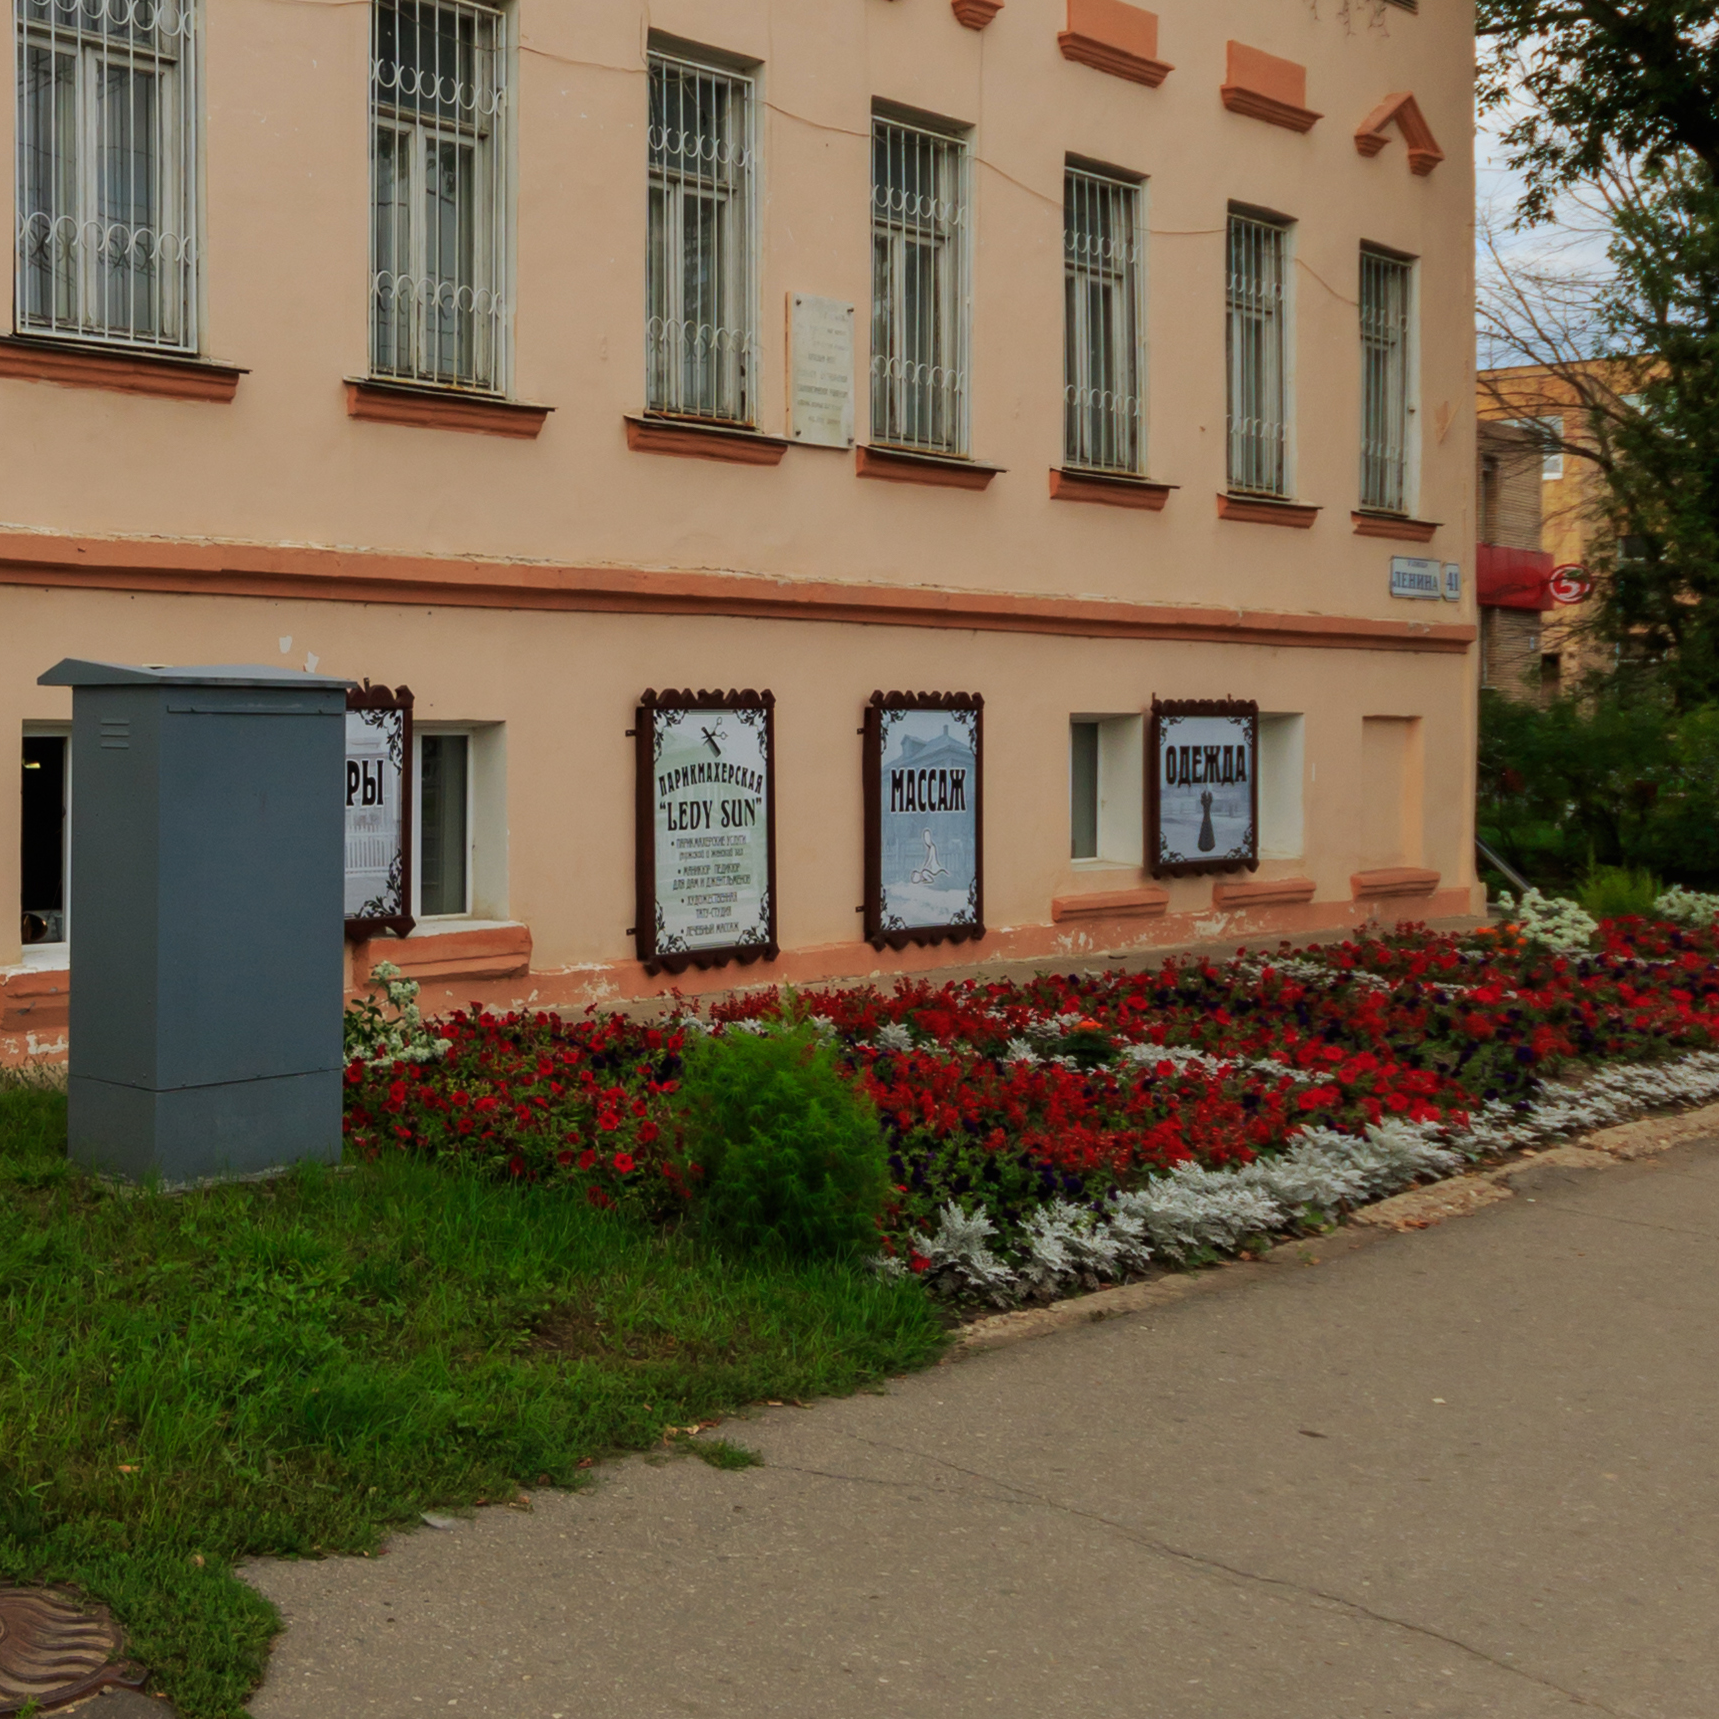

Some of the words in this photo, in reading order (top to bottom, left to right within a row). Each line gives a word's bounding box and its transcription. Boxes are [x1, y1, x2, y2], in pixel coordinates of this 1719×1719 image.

[1393, 570, 1439, 592] ЛЕНИНА
[659, 762, 763, 796] ПАРИКМАХЕРСКАЯ
[1166, 745, 1247, 788] ОДЕЖДА
[890, 768, 966, 812] МАССАЖ
